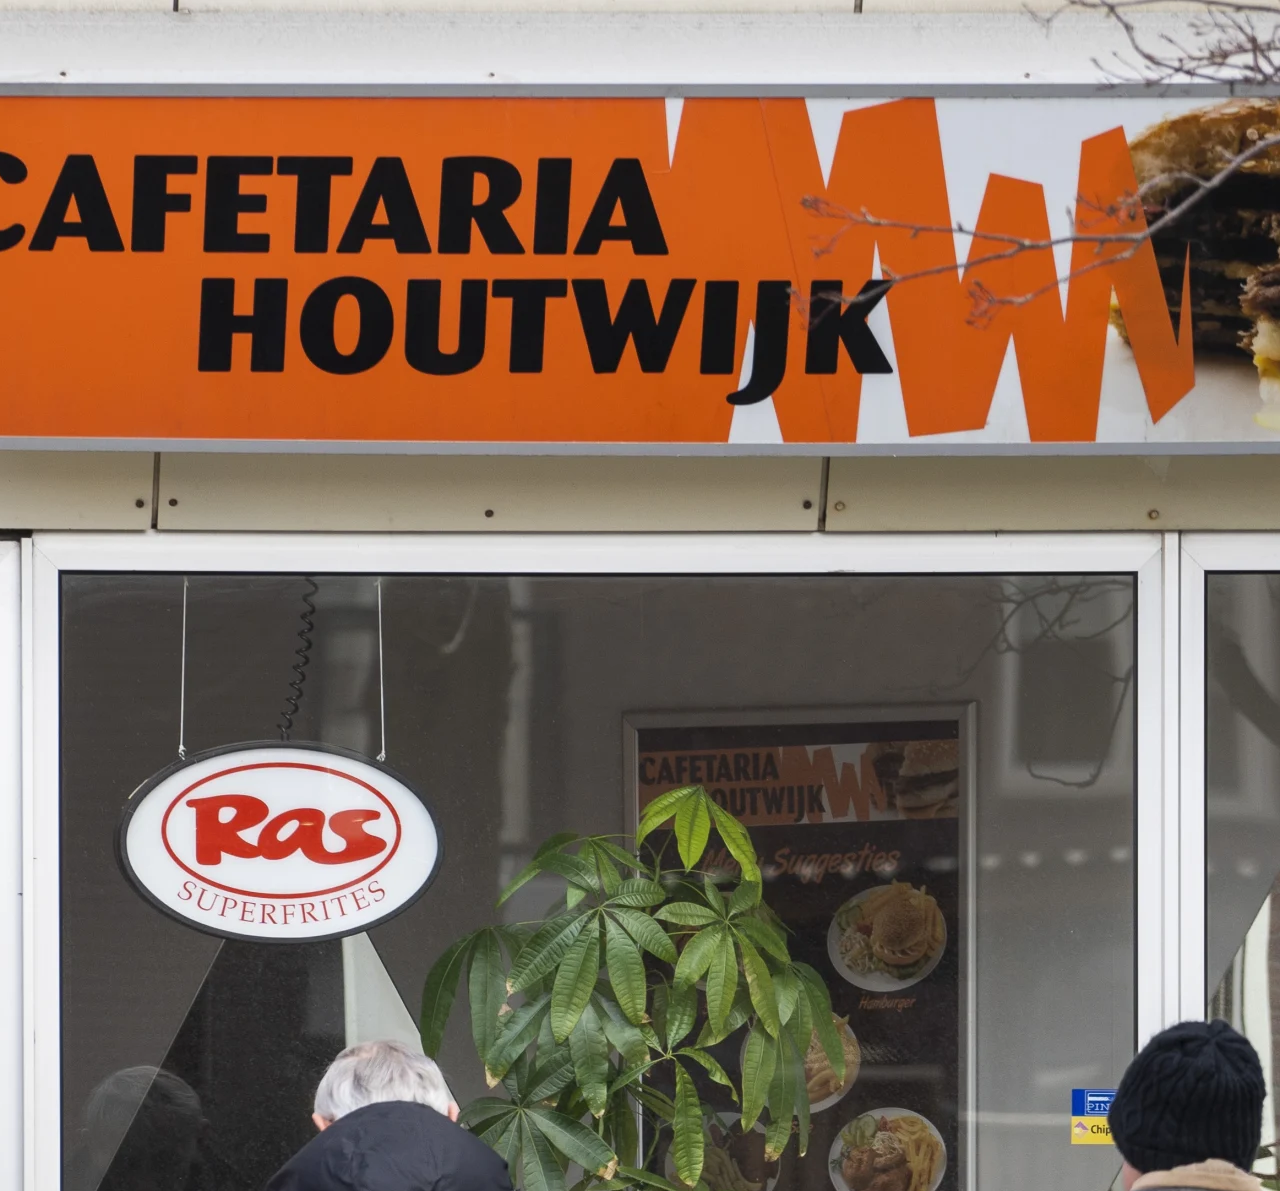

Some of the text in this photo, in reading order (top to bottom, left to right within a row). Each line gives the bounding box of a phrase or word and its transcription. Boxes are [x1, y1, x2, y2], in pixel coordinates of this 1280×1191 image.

[197, 276, 894, 407] HOUTWIJK
[638, 751, 780, 786] CAFETARIA
[710, 784, 827, 823] OUTWIJK
[185, 793, 388, 866] Ras
[773, 843, 901, 884] Suggesties
[177, 879, 387, 925] SUPERFRITES
[858, 994, 917, 1012] Hamburger
[1091, 1124, 1112, 1137] Chip
